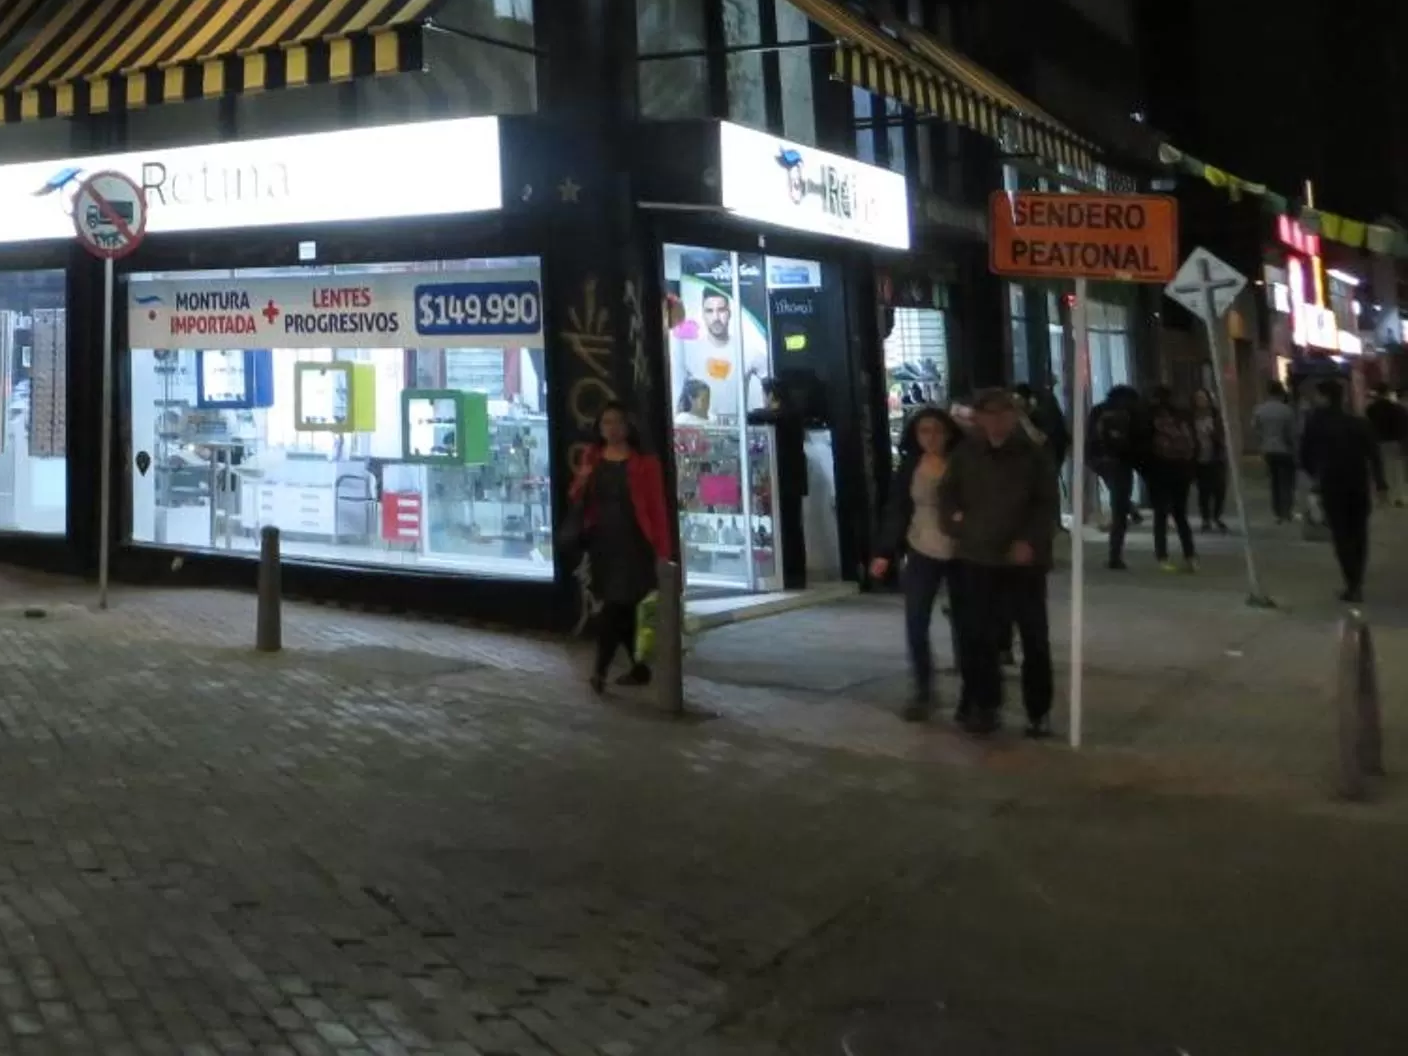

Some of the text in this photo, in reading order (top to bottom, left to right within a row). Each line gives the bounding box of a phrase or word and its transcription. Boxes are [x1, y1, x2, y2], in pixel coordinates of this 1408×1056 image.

[141, 160, 290, 207] Retina
[1013, 200, 1146, 231] SENDERO
[1011, 239, 1159, 273] PEATONAL
[175, 291, 250, 311] MONTURA
[312, 288, 371, 308] LENTES
[419, 292, 538, 326] $149.990
[170, 315, 257, 335] IMPORTADA
[284, 312, 400, 334] PROGRESIVOS
